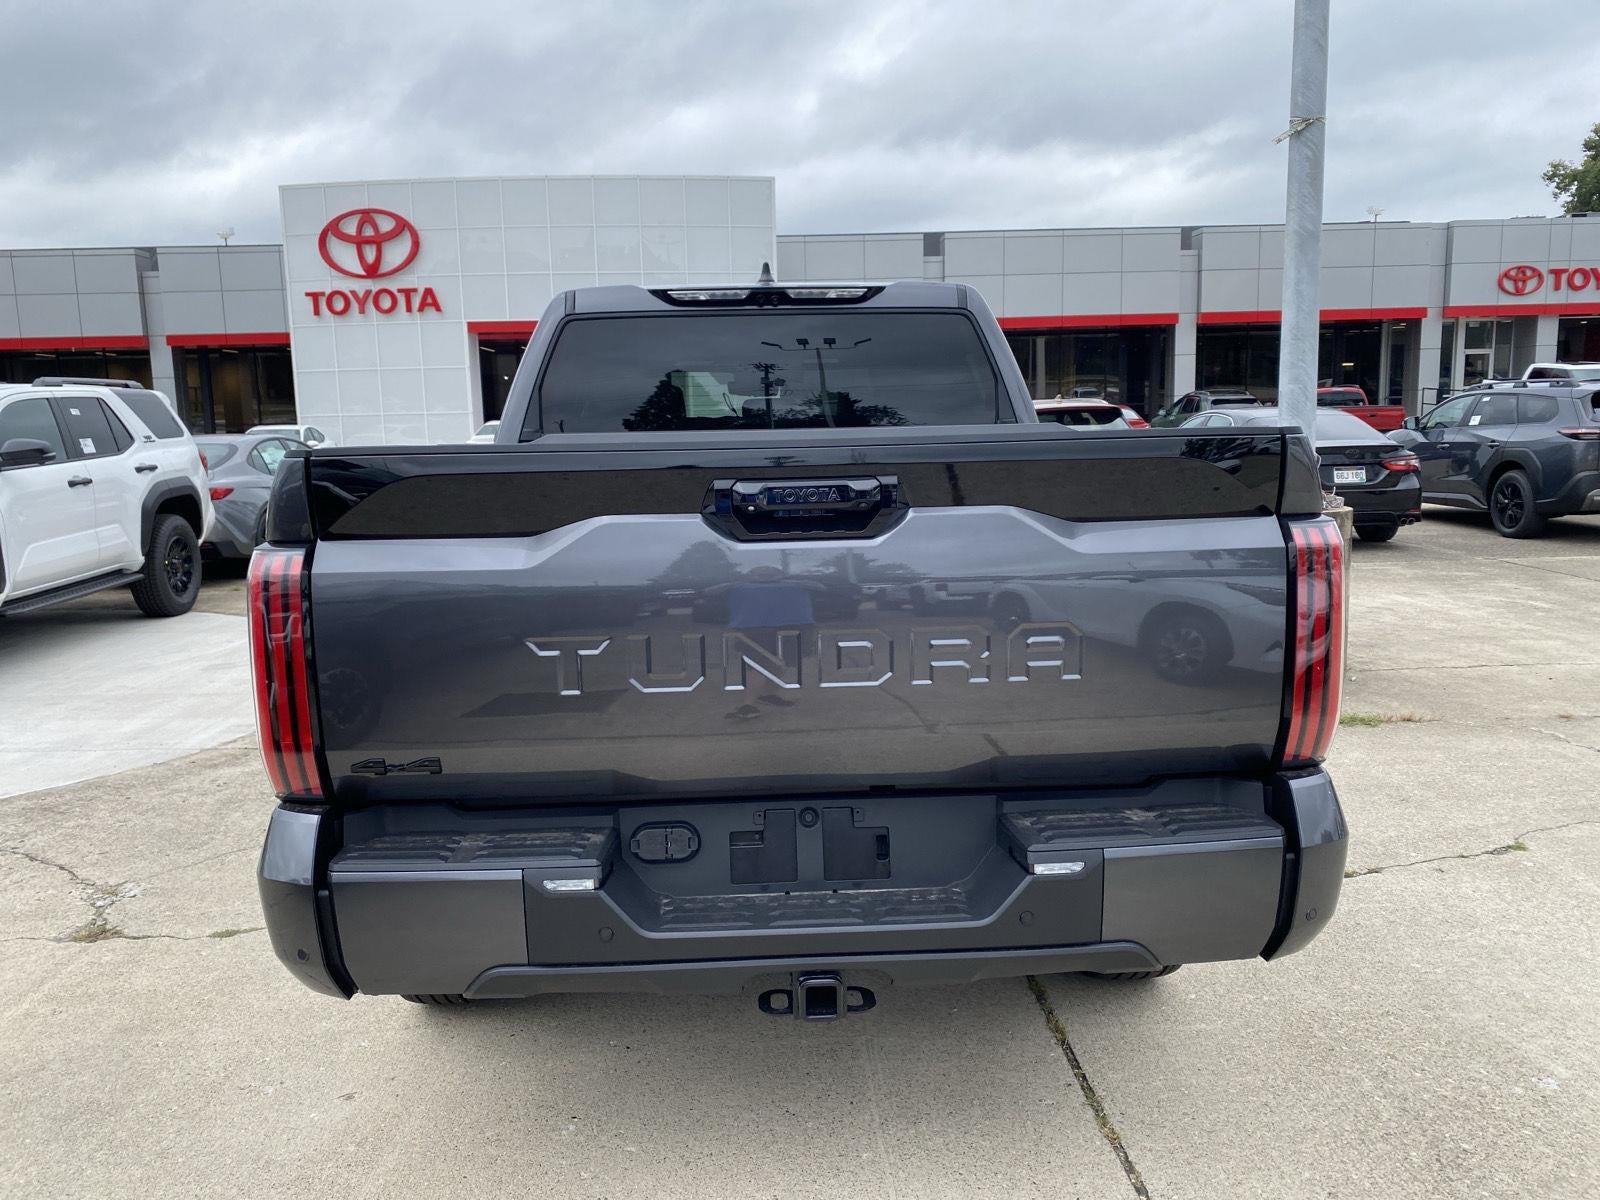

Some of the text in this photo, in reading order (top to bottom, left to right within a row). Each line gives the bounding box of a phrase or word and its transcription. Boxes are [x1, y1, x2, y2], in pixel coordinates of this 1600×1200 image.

[305, 287, 442, 317] TOYOTA
[773, 487, 840, 504] TOYOTA
[524, 620, 1084, 697] TUNDRA
